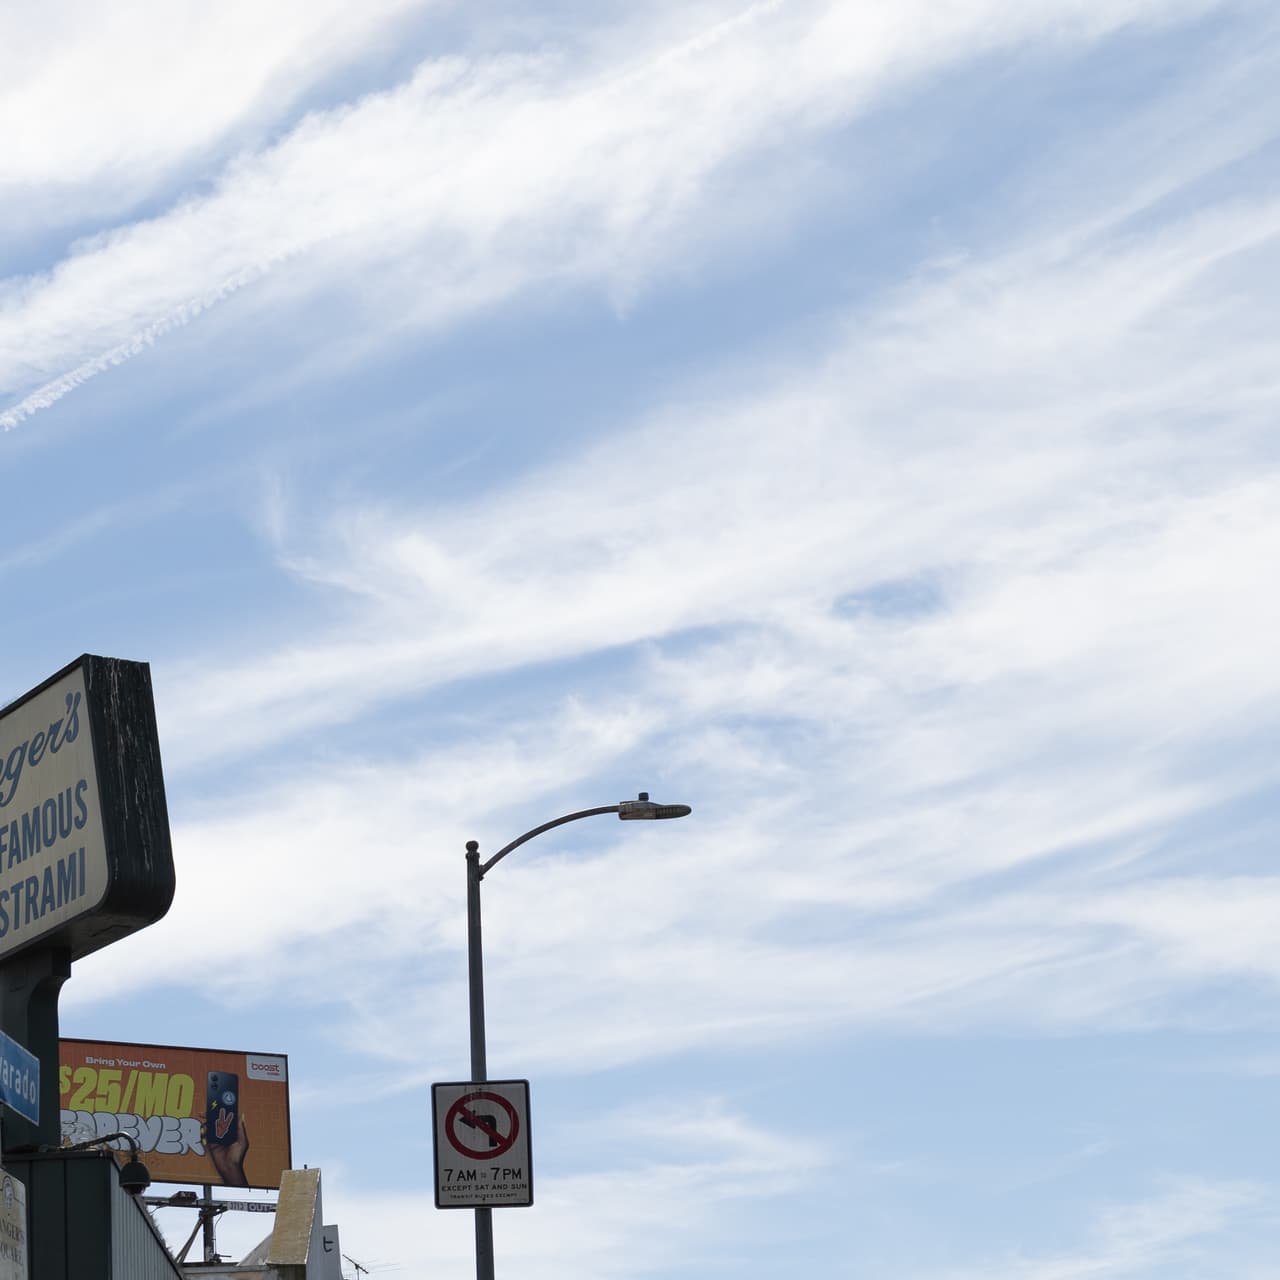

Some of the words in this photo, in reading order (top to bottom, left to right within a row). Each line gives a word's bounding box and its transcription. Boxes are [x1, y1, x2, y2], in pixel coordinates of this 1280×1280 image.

[85, 1056, 115, 1067] Bring
[116, 1058, 141, 1068] Your
[142, 1059, 166, 1070] Own
[251, 1062, 280, 1073] boost
[59, 1063, 195, 1118] $25/MO
[443, 1168, 453, 1182] 7
[457, 1169, 477, 1181] AM
[490, 1167, 500, 1180] 7
[502, 1168, 522, 1180] PM
